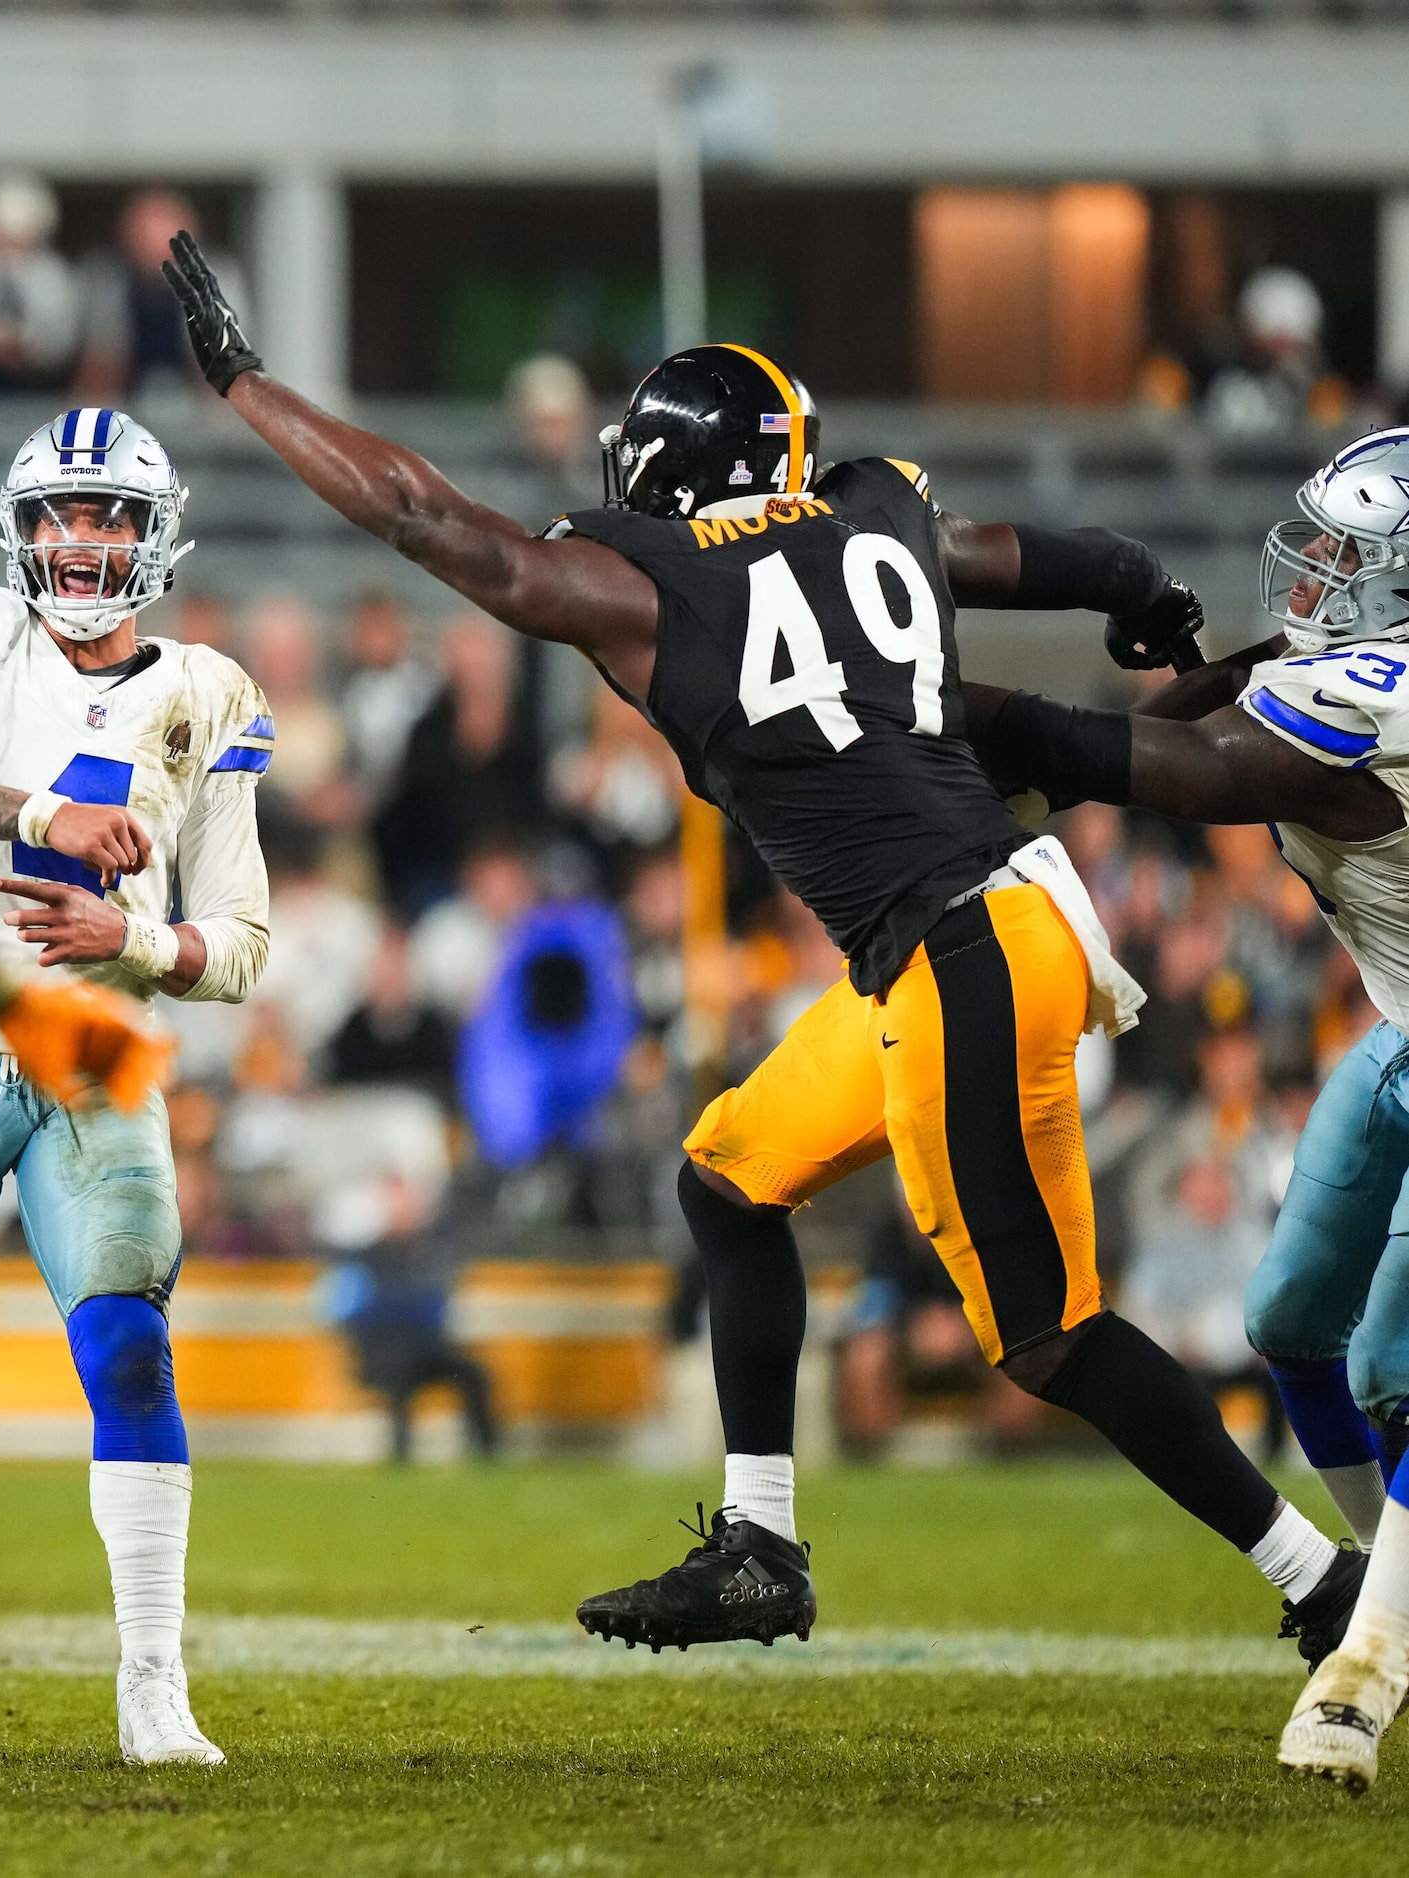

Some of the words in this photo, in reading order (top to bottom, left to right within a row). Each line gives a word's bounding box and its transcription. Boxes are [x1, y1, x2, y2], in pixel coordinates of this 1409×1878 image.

[60, 467, 102, 475] COWBOYS
[770, 453, 814, 493] 49
[738, 533, 945, 753] 49
[719, 1582, 790, 1605] adidas
